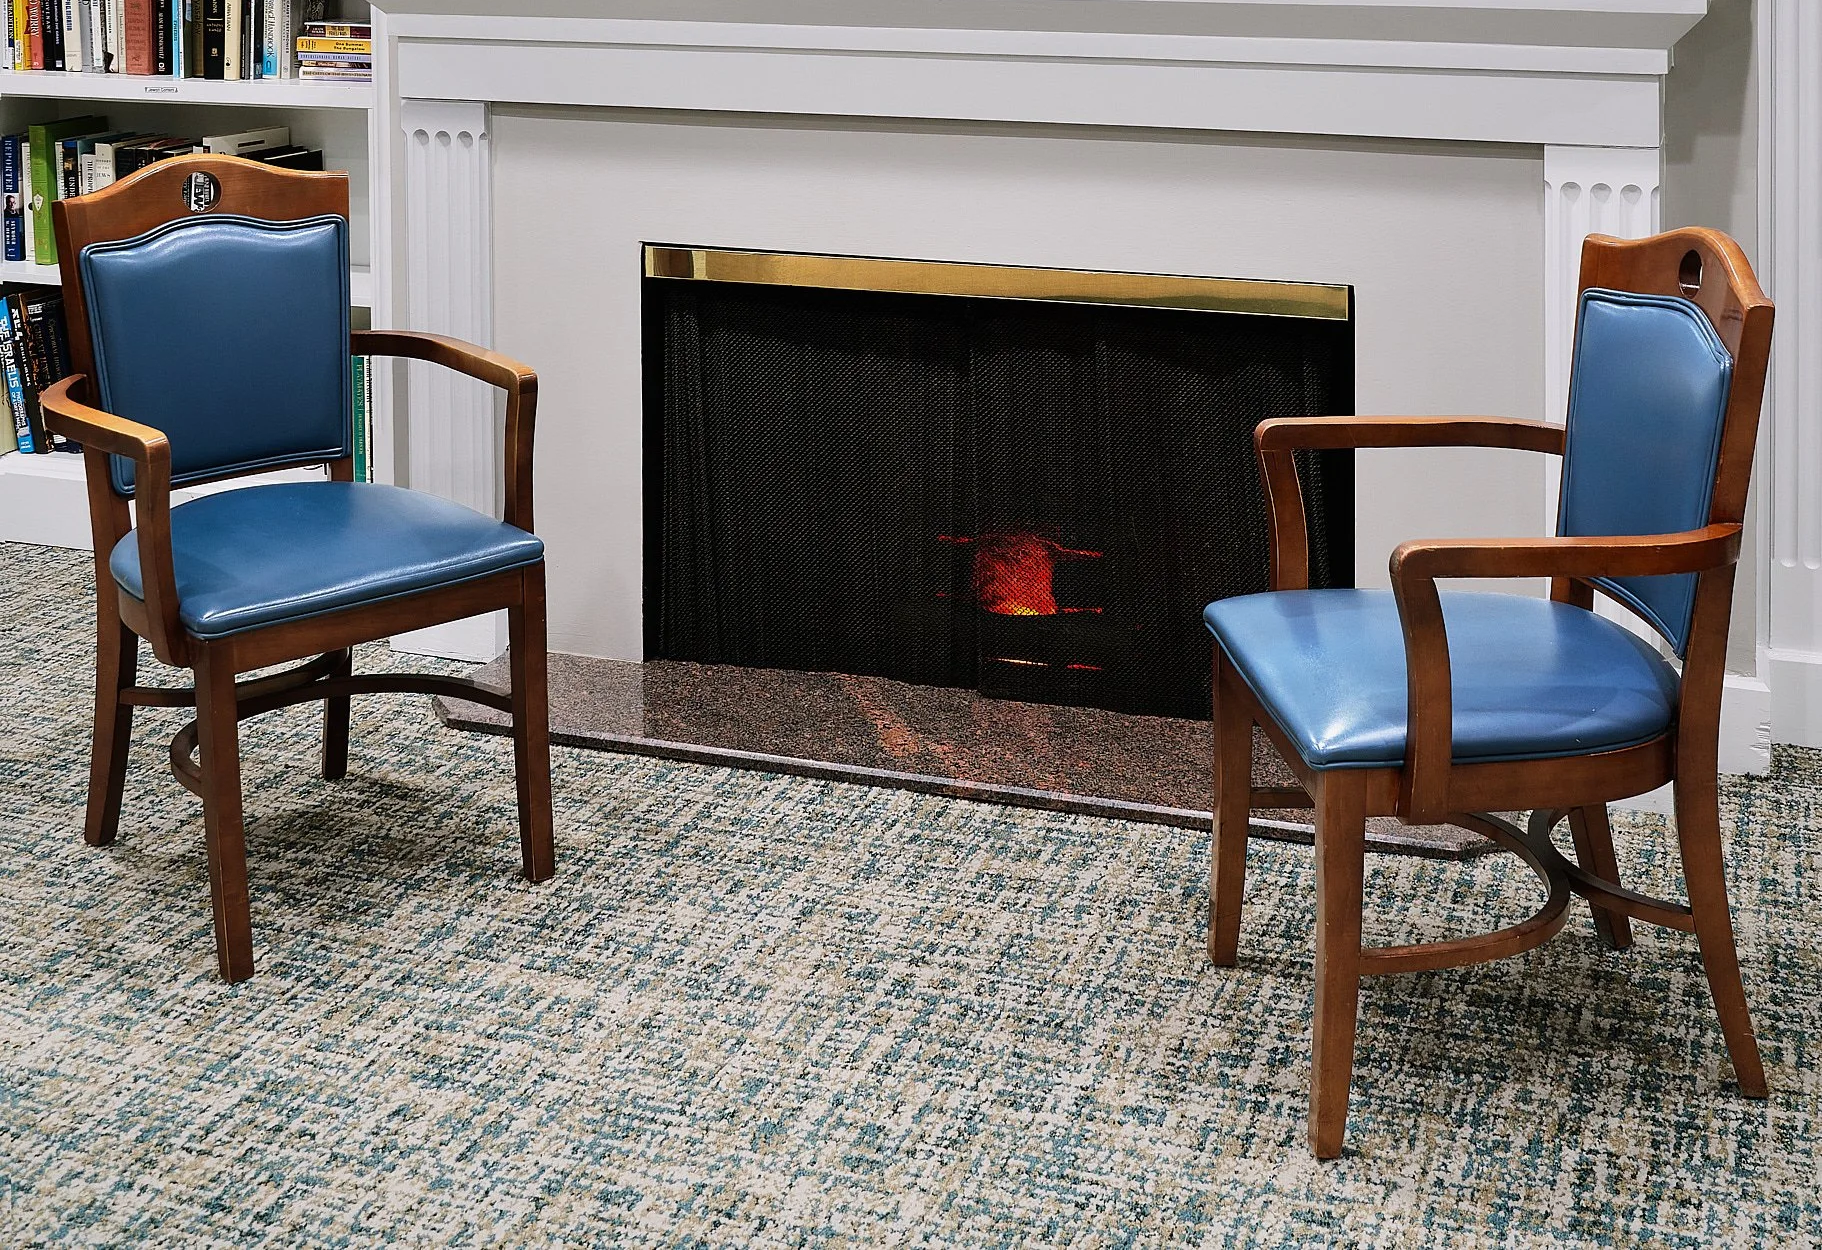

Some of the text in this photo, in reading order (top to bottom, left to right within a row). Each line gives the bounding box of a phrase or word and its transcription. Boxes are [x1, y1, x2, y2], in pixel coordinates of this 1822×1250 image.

[30, 7, 39, 37] WORRY
[194, 21, 203, 35] Jew
[266, 21, 276, 58] HANDBOOK
[4, 141, 13, 191] REPORTER
[3, 340, 19, 388] ISRAELIS
